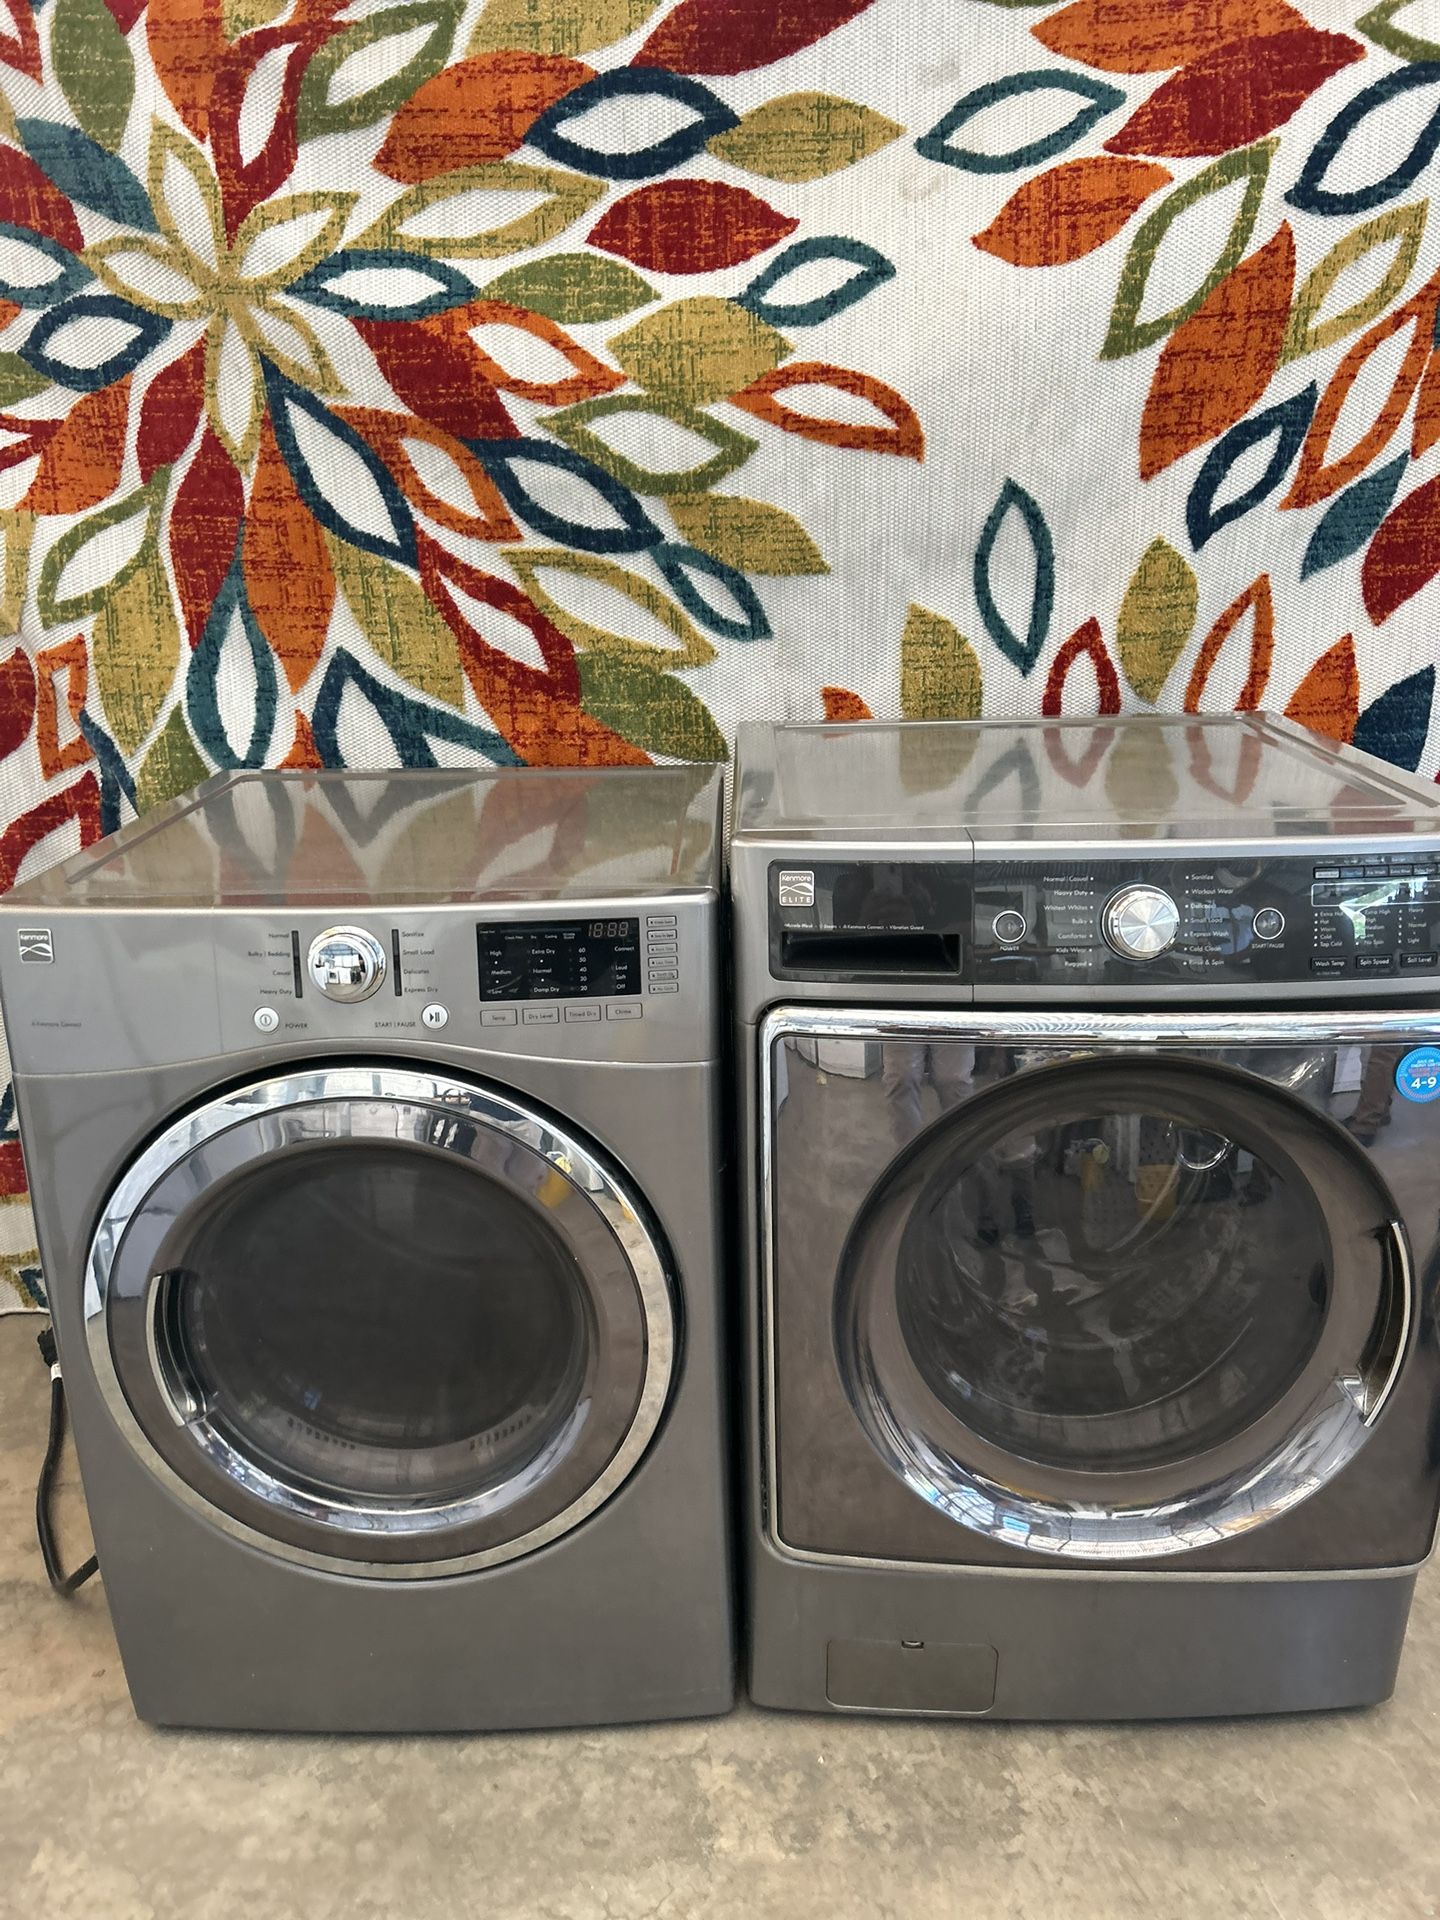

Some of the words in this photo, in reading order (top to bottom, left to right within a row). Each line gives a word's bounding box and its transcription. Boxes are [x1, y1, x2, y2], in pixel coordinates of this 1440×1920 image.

[781, 874, 812, 882] Kenmore
[247, 951, 263, 959] Bulky
[267, 951, 291, 959] Bedding
[279, 988, 293, 996] Duty
[404, 986, 426, 994] Express
[427, 986, 438, 994] Dry
[1411, 1076, 1437, 1089] 4-9
